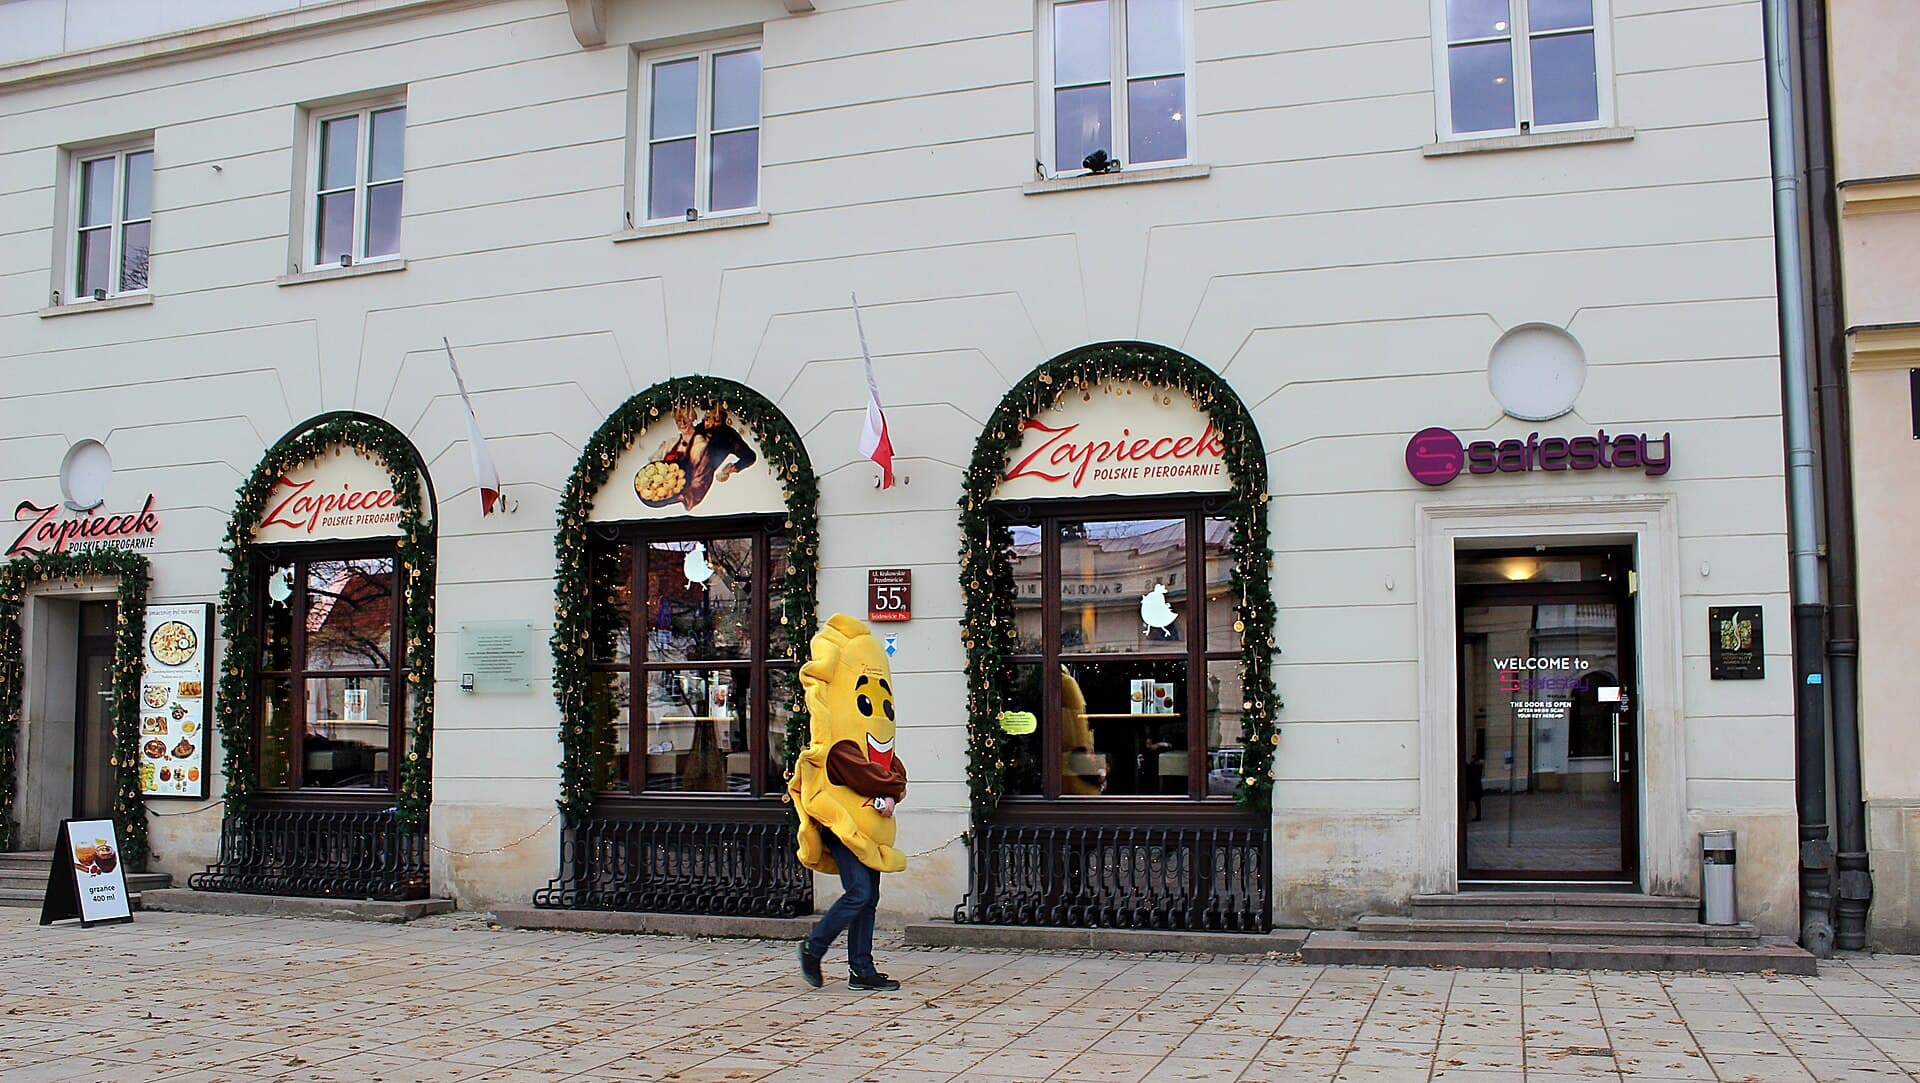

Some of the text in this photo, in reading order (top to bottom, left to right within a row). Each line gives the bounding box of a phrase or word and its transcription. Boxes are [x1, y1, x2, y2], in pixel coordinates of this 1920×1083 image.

[1005, 417, 1227, 488] Zapiecek
[1468, 429, 1671, 476] safestay
[1093, 463, 1221, 480] POLSKIE PIEROGARNIE
[260, 476, 401, 534] Zapiece
[4, 493, 159, 556] Zapiecek
[322, 515, 354, 527] POLSKIE
[875, 586, 902, 610] 55
[1493, 657, 1590, 670] WELCOME to
[1523, 675, 1589, 691] safestay
[107, 893, 115, 901] ml
